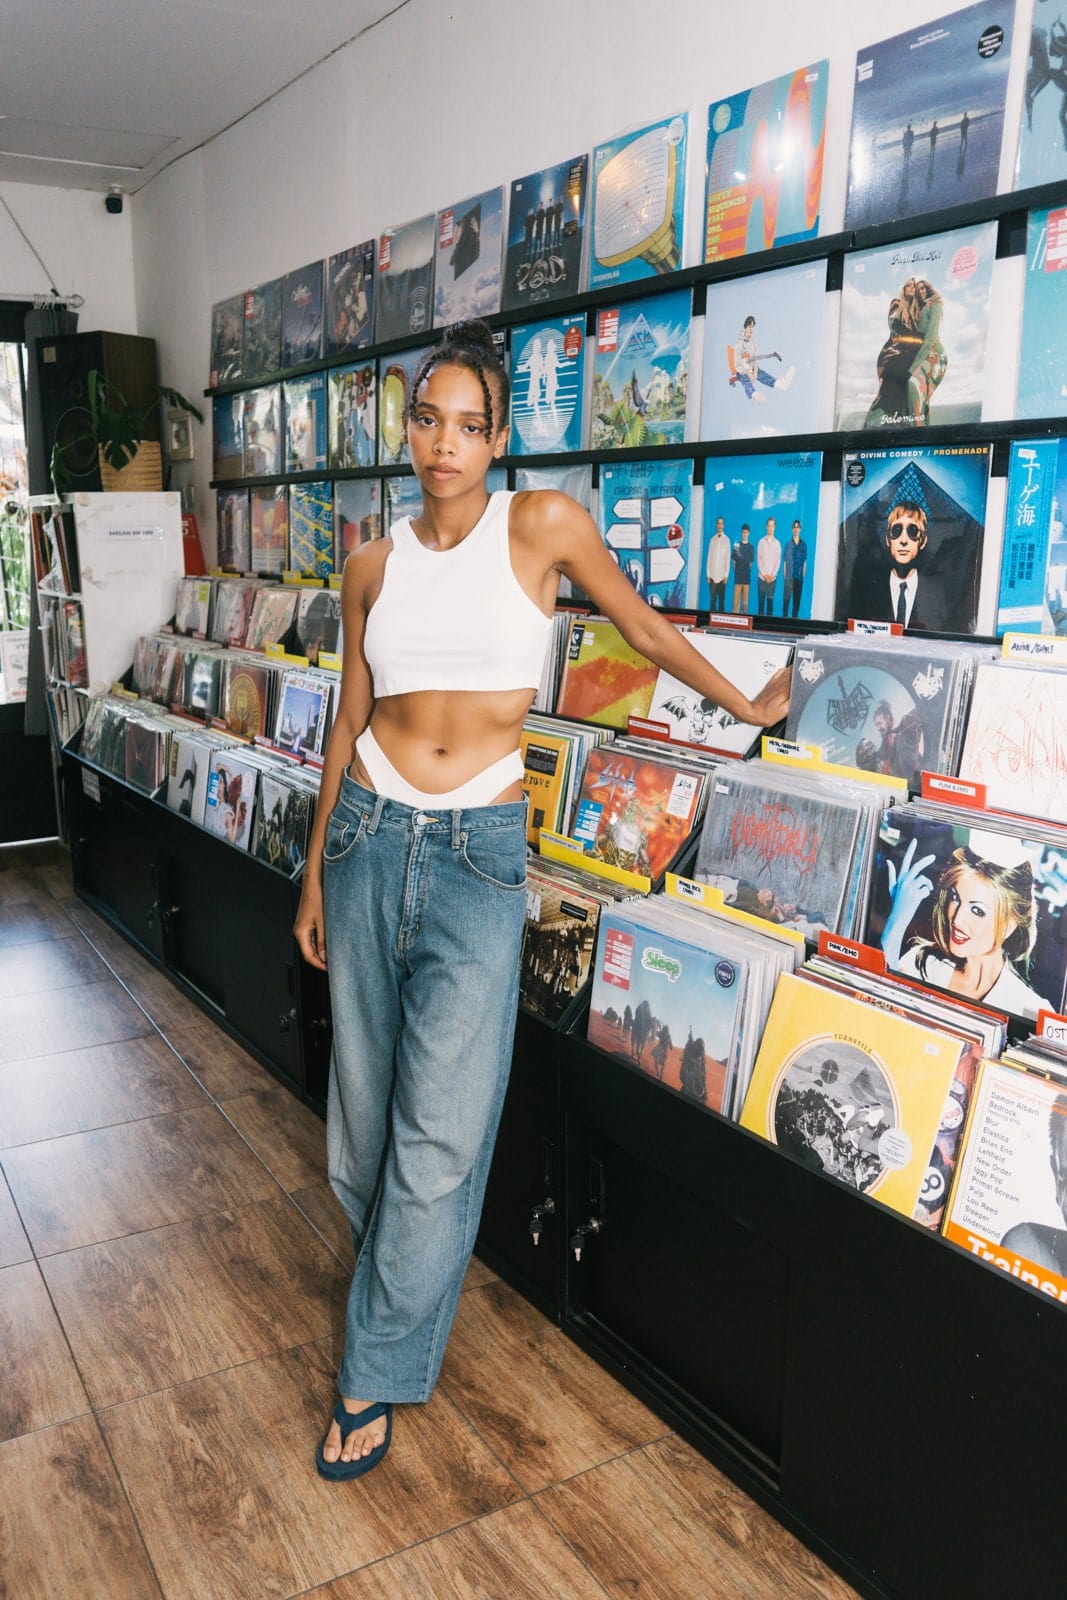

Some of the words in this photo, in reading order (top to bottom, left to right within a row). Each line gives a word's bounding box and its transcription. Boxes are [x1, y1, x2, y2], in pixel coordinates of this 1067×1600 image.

[881, 411, 926, 425] Palomino
[777, 456, 816, 468] weezer
[889, 450, 924, 458] COMEDY
[934, 448, 988, 456] PROMENADE
[645, 950, 681, 981] Sleep
[1047, 1026, 1067, 1041] OST
[833, 1033, 873, 1054] TURNSTILE
[989, 1101, 1017, 1117] Bedrock
[991, 1092, 1015, 1105] Damon
[1016, 1103, 1040, 1117] Albarn
[985, 1116, 999, 1127] Blur
[983, 1126, 1009, 1143] Elastica
[981, 1136, 998, 1149] Brian
[1000, 1145, 1013, 1156] Eno
[974, 1166, 988, 1178] Iggy
[990, 1173, 1003, 1185] Pop
[976, 1157, 990, 1167] New
[992, 1164, 1013, 1177] Order
[969, 1185, 984, 1197] Pulp
[972, 1176, 992, 1190] Primal
[994, 1187, 1021, 1204] Scream
[965, 1205, 989, 1221] Sleeper
[967, 1196, 979, 1206] Lou
[981, 1202, 999, 1216] Reed
[963, 1216, 1001, 1239] Underworld
